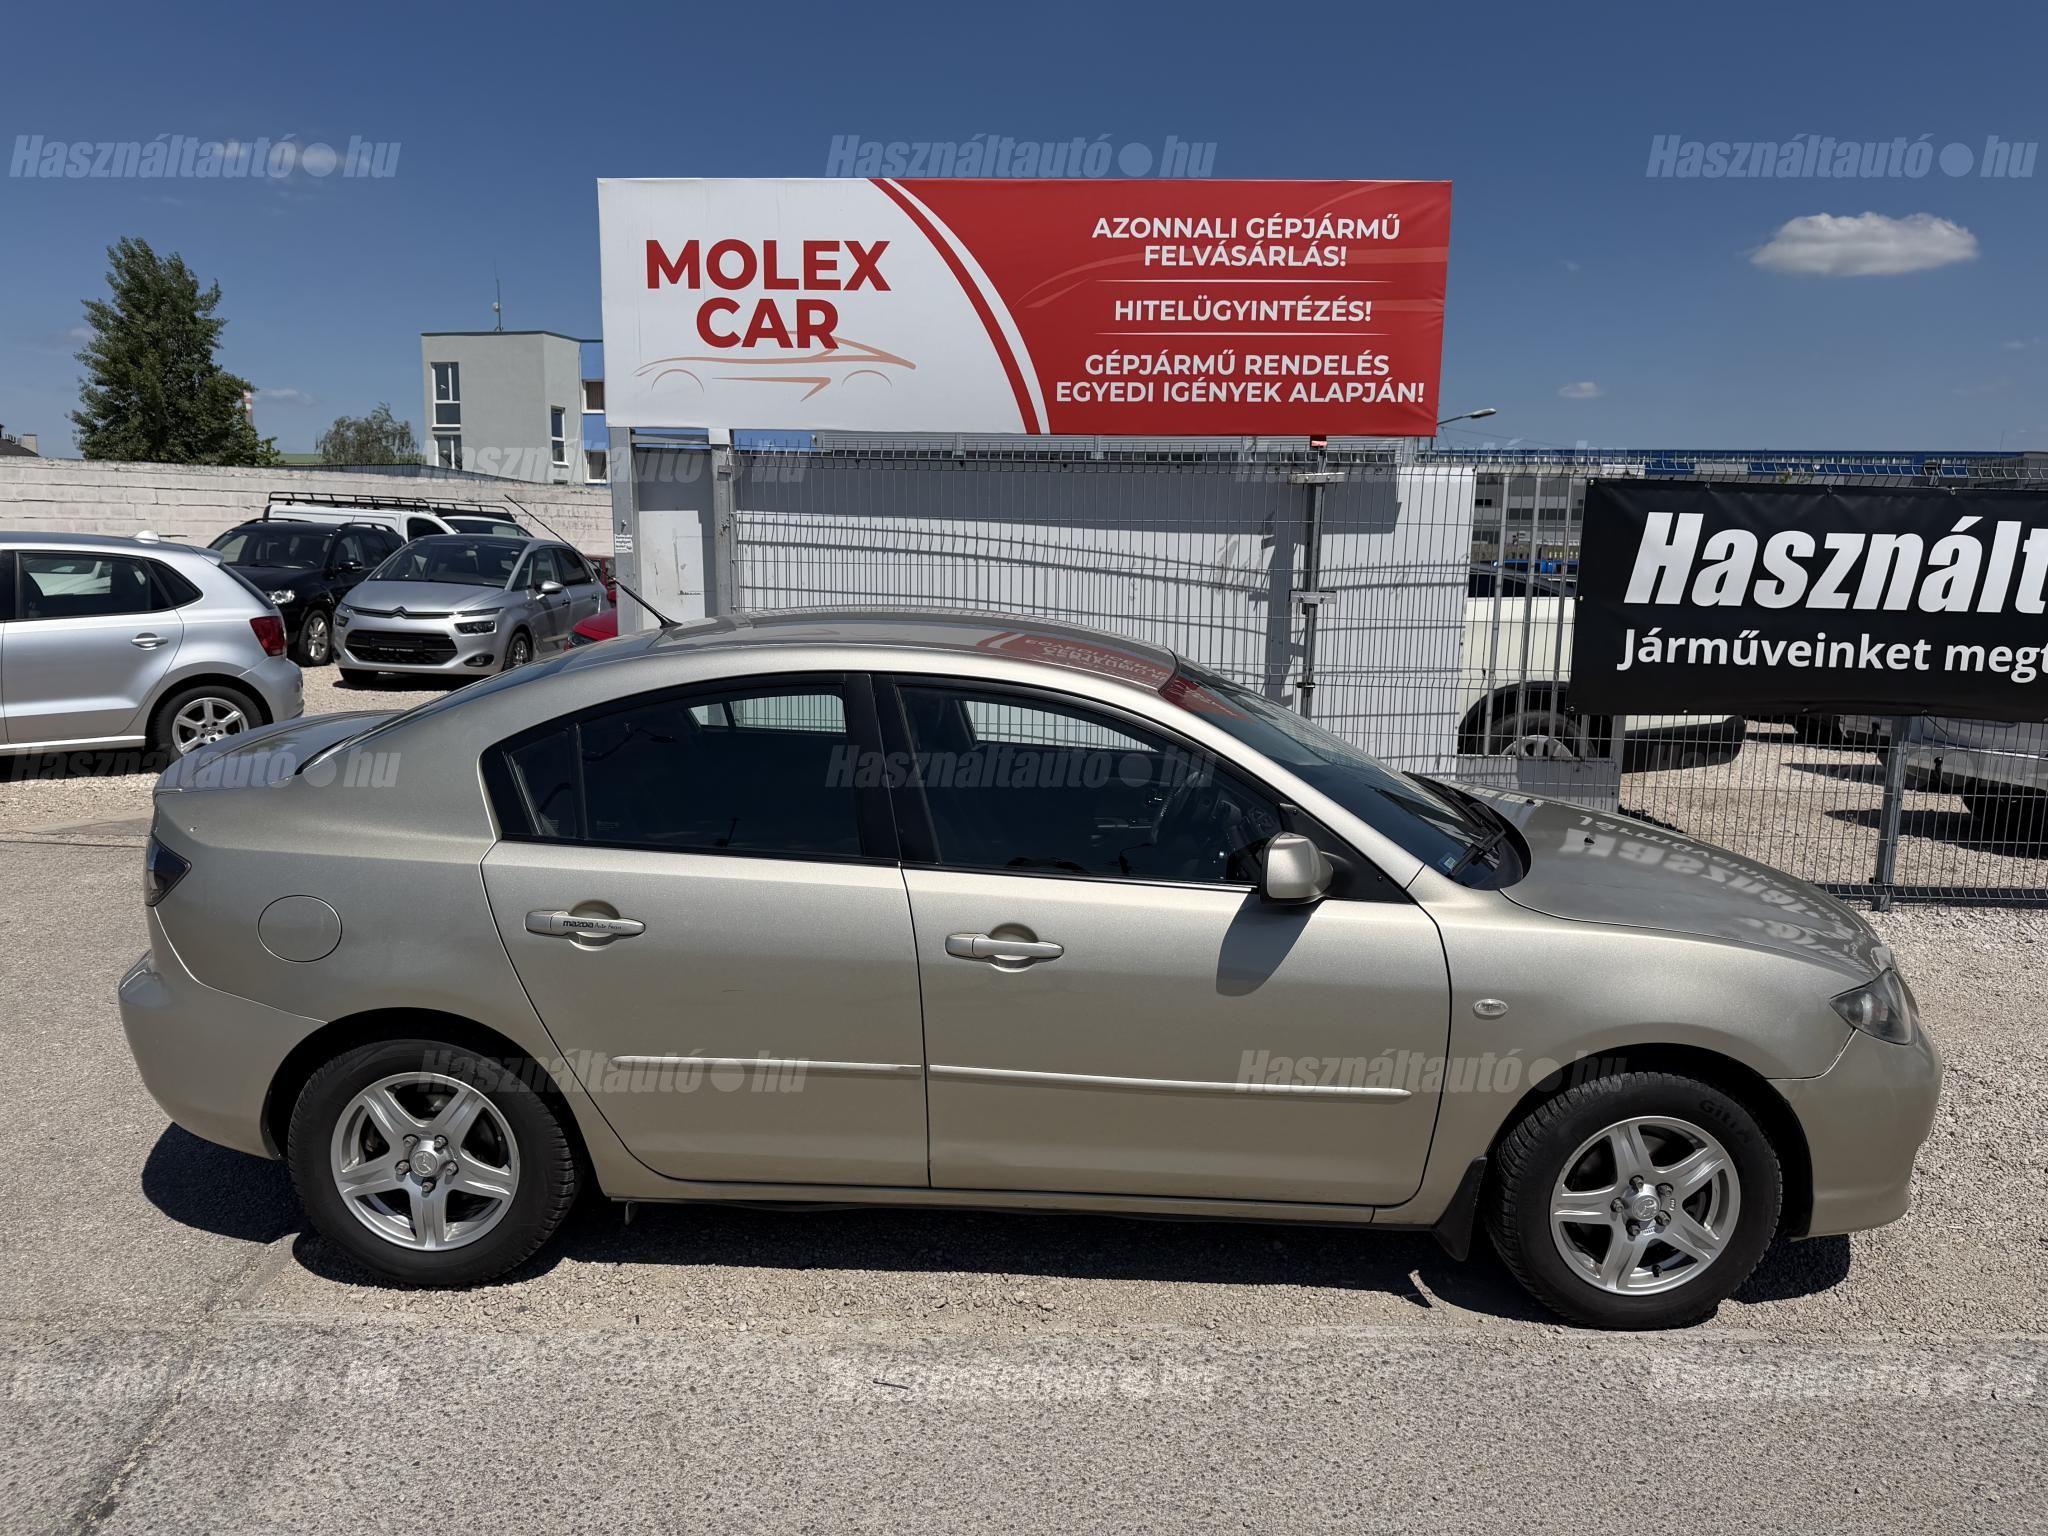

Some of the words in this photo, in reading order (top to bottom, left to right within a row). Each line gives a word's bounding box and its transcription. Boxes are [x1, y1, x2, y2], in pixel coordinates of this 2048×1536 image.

[1092, 217, 1237, 239] AZONNALI
[1246, 213, 1401, 240] GÉPJÁRMŰ
[646, 239, 892, 292] MOLEX
[1144, 241, 1347, 267] FELVÁSÁRLÁS!
[1114, 294, 1372, 322] HITELÜGYINTÉZÉS!
[696, 297, 840, 349] CAR
[1085, 349, 1236, 376] GÉPJÁRMŰ
[1244, 350, 1389, 376] RENDELÉS
[1056, 381, 1154, 402] EGYEDI
[1163, 377, 1283, 403] IGÉNYEK
[1288, 377, 1425, 403] ALAPJÁN!
[1623, 511, 2048, 614] Használt
[1616, 628, 1931, 673] Járműveinket
